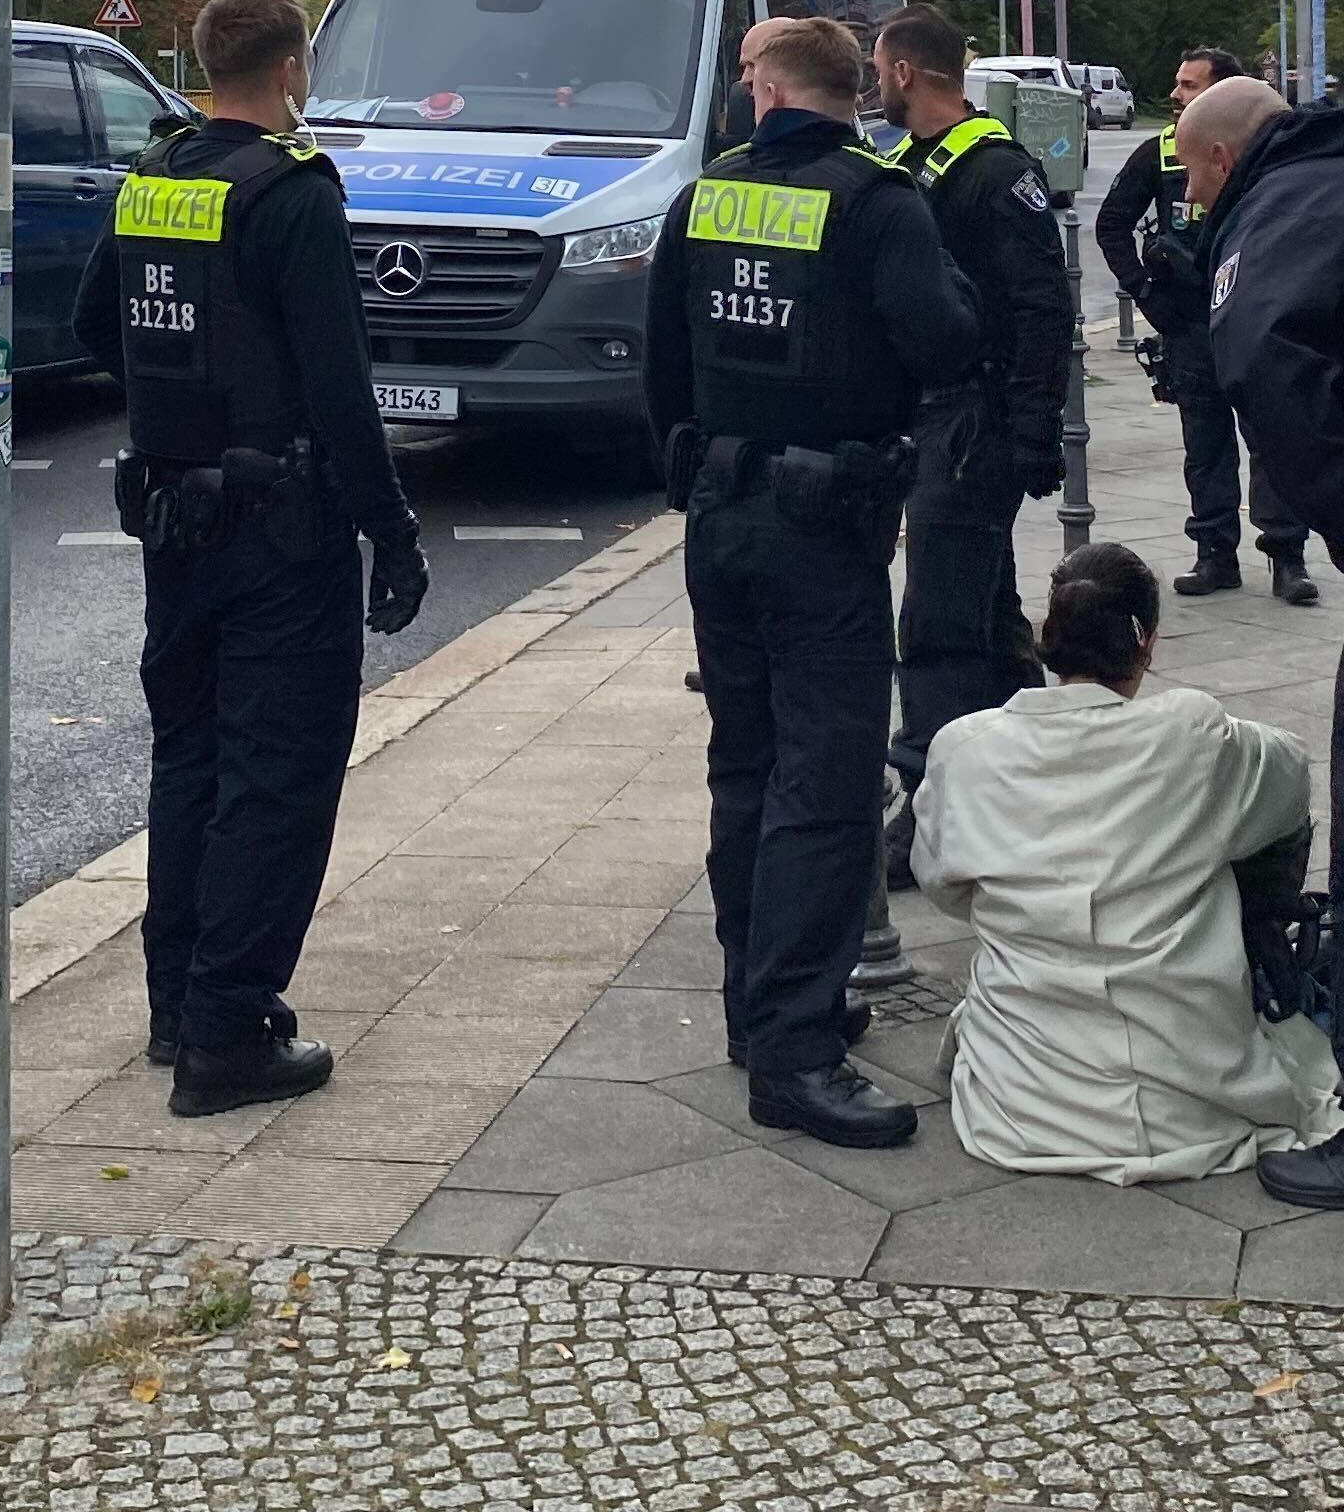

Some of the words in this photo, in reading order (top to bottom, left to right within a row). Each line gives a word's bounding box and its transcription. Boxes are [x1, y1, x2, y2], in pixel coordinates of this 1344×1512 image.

[338, 163, 524, 189] POLIZEI
[534, 177, 570, 196] 31
[119, 182, 218, 230] POLIZEI
[691, 185, 826, 246] POLIZEI
[145, 263, 174, 295] BE
[734, 258, 770, 290] BE
[129, 297, 196, 332] 31218
[710, 290, 795, 328] 31137
[376, 387, 441, 411] 31543
